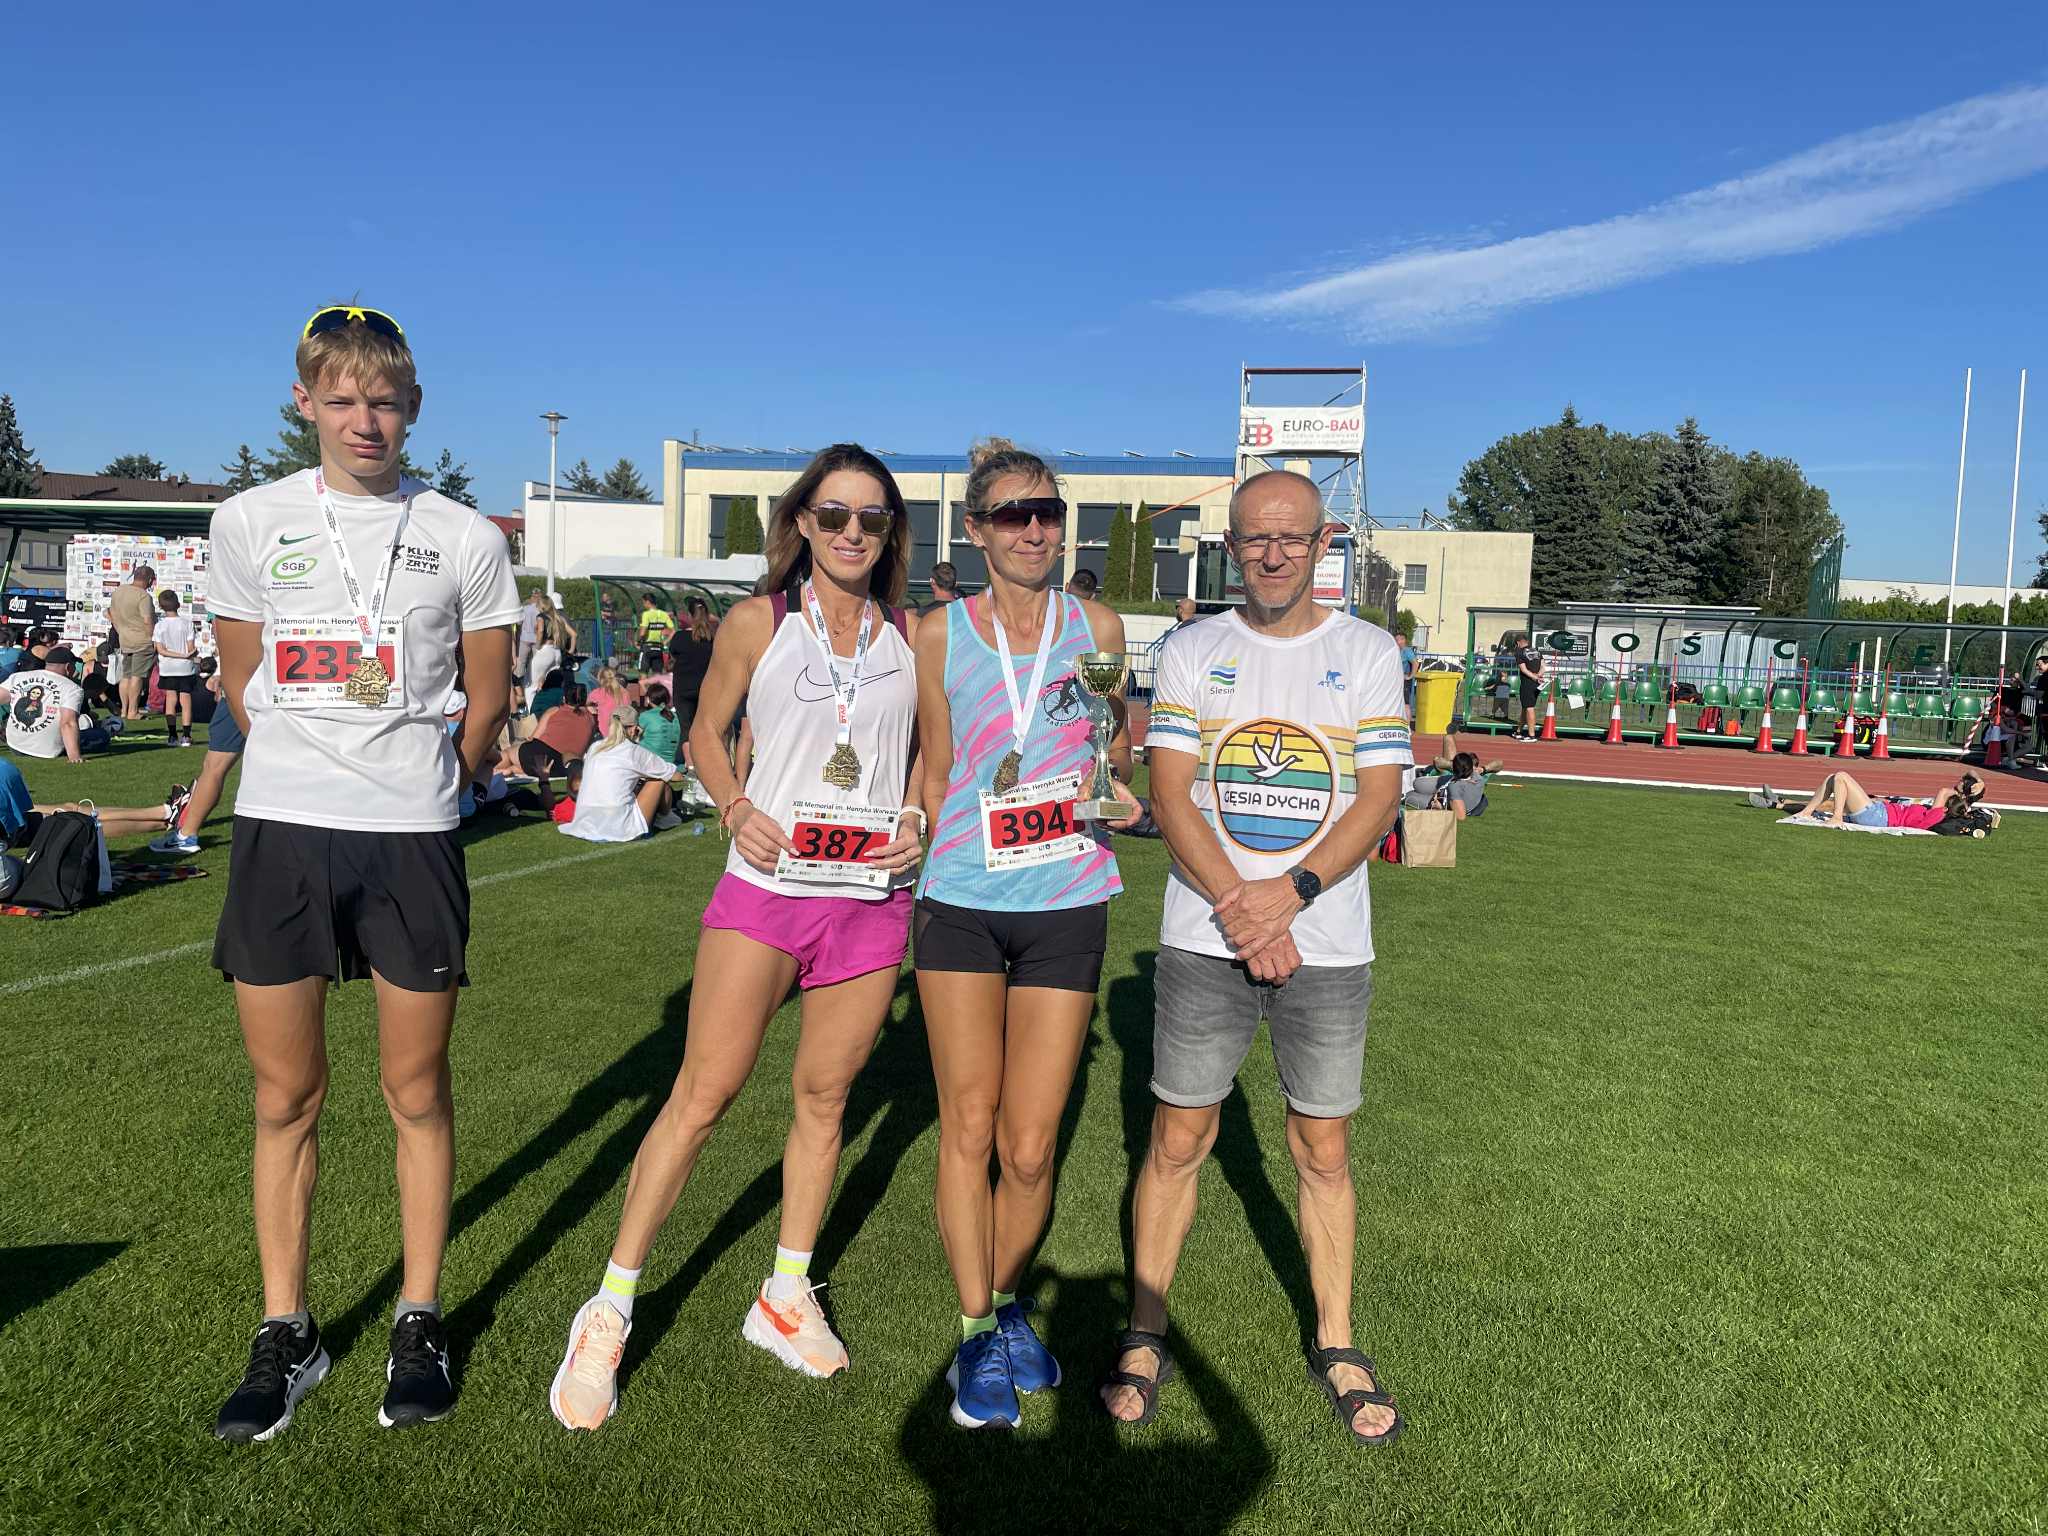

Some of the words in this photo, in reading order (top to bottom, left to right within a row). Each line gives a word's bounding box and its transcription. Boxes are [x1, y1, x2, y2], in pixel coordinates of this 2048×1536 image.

[1283, 420, 1360, 432] EURO-BAU
[408, 547, 439, 559] KLUB
[281, 562, 306, 571] SGB
[406, 559, 440, 570] ZRYW
[280, 617, 315, 625] Memorial
[286, 645, 364, 680] 235
[1032, 780, 1056, 791] Henryka
[1224, 791, 1261, 806] GĘSIA
[1266, 795, 1320, 811] DYCHA
[804, 801, 834, 810] Memorial
[846, 805, 872, 814] Henryka
[1001, 802, 1068, 846] 394
[800, 827, 872, 860] 387
